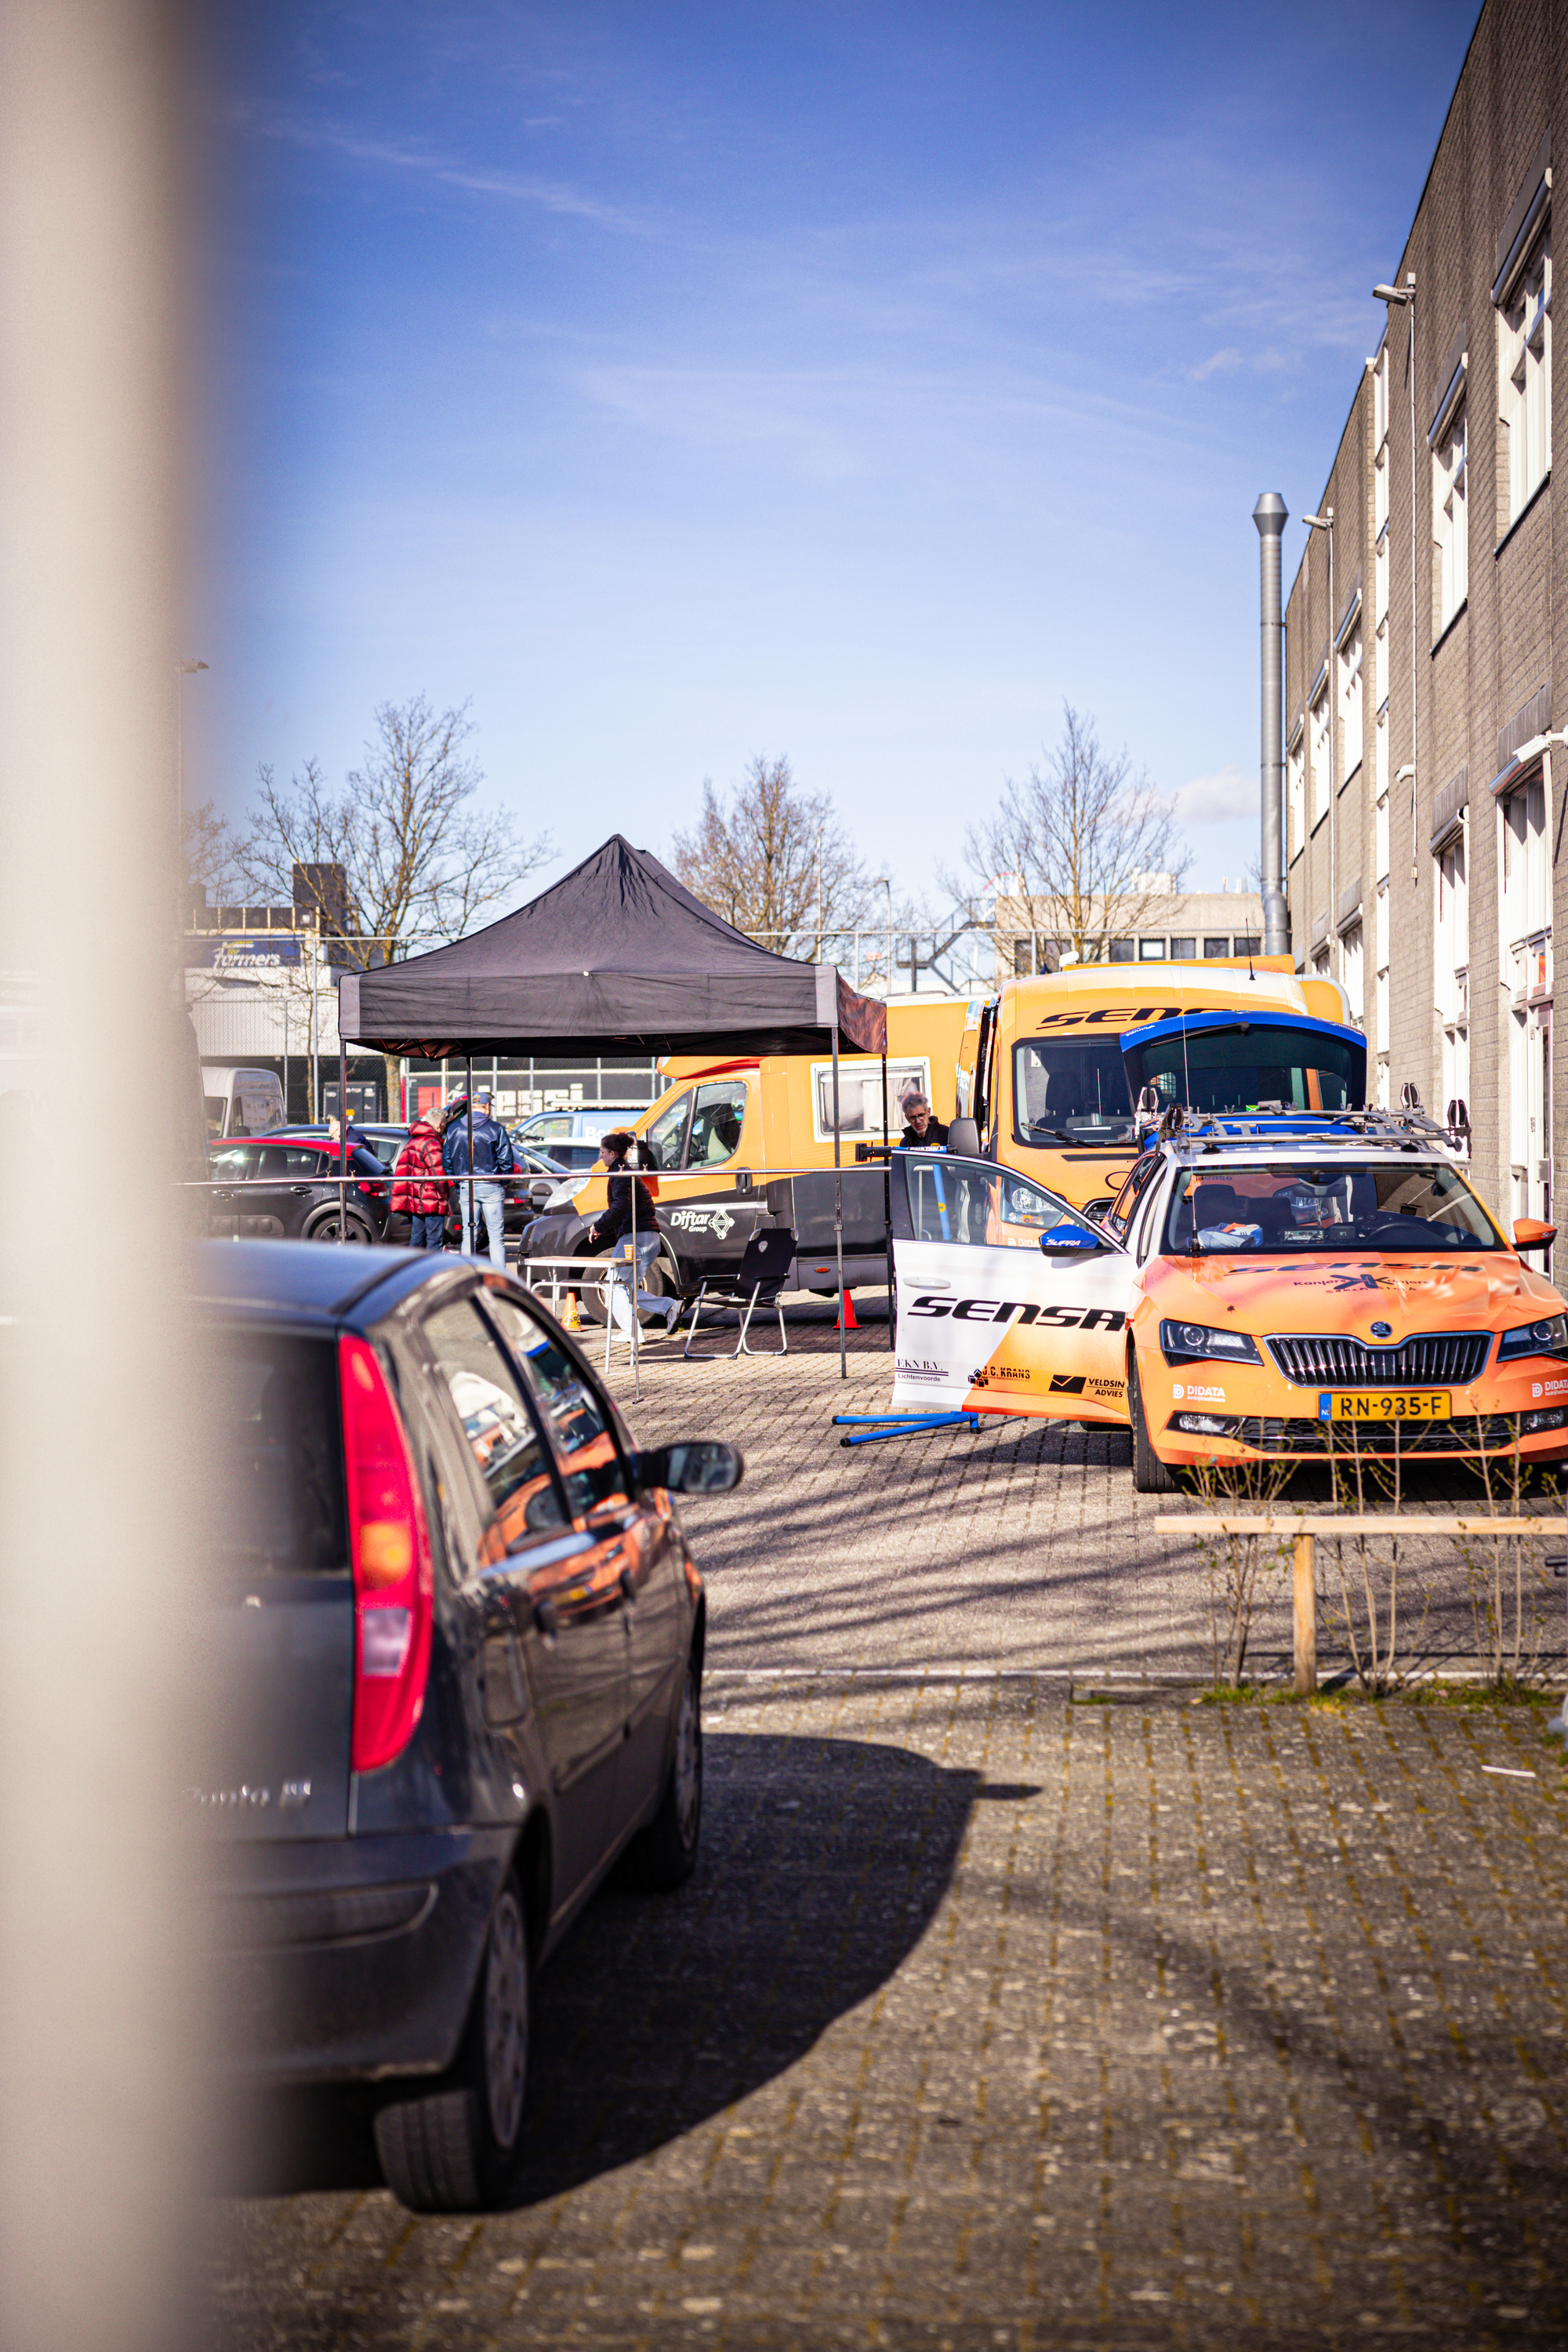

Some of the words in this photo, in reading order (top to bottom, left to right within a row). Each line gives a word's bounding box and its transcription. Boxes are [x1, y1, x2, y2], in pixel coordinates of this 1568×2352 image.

[670, 1210, 710, 1229] Diftar
[907, 1296, 1126, 1331] SENSA
[897, 1359, 920, 1369] EKN
[924, 1360, 943, 1371] B.V.
[898, 1373, 941, 1382] Lichtenvoorde
[1000, 1367, 1030, 1379] KRANS
[1088, 1378, 1125, 1388] VELDSIN
[1095, 1388, 1123, 1398] ADVIES
[1187, 1385, 1225, 1397] DIDATA
[1341, 1396, 1442, 1416] RN-935-F
